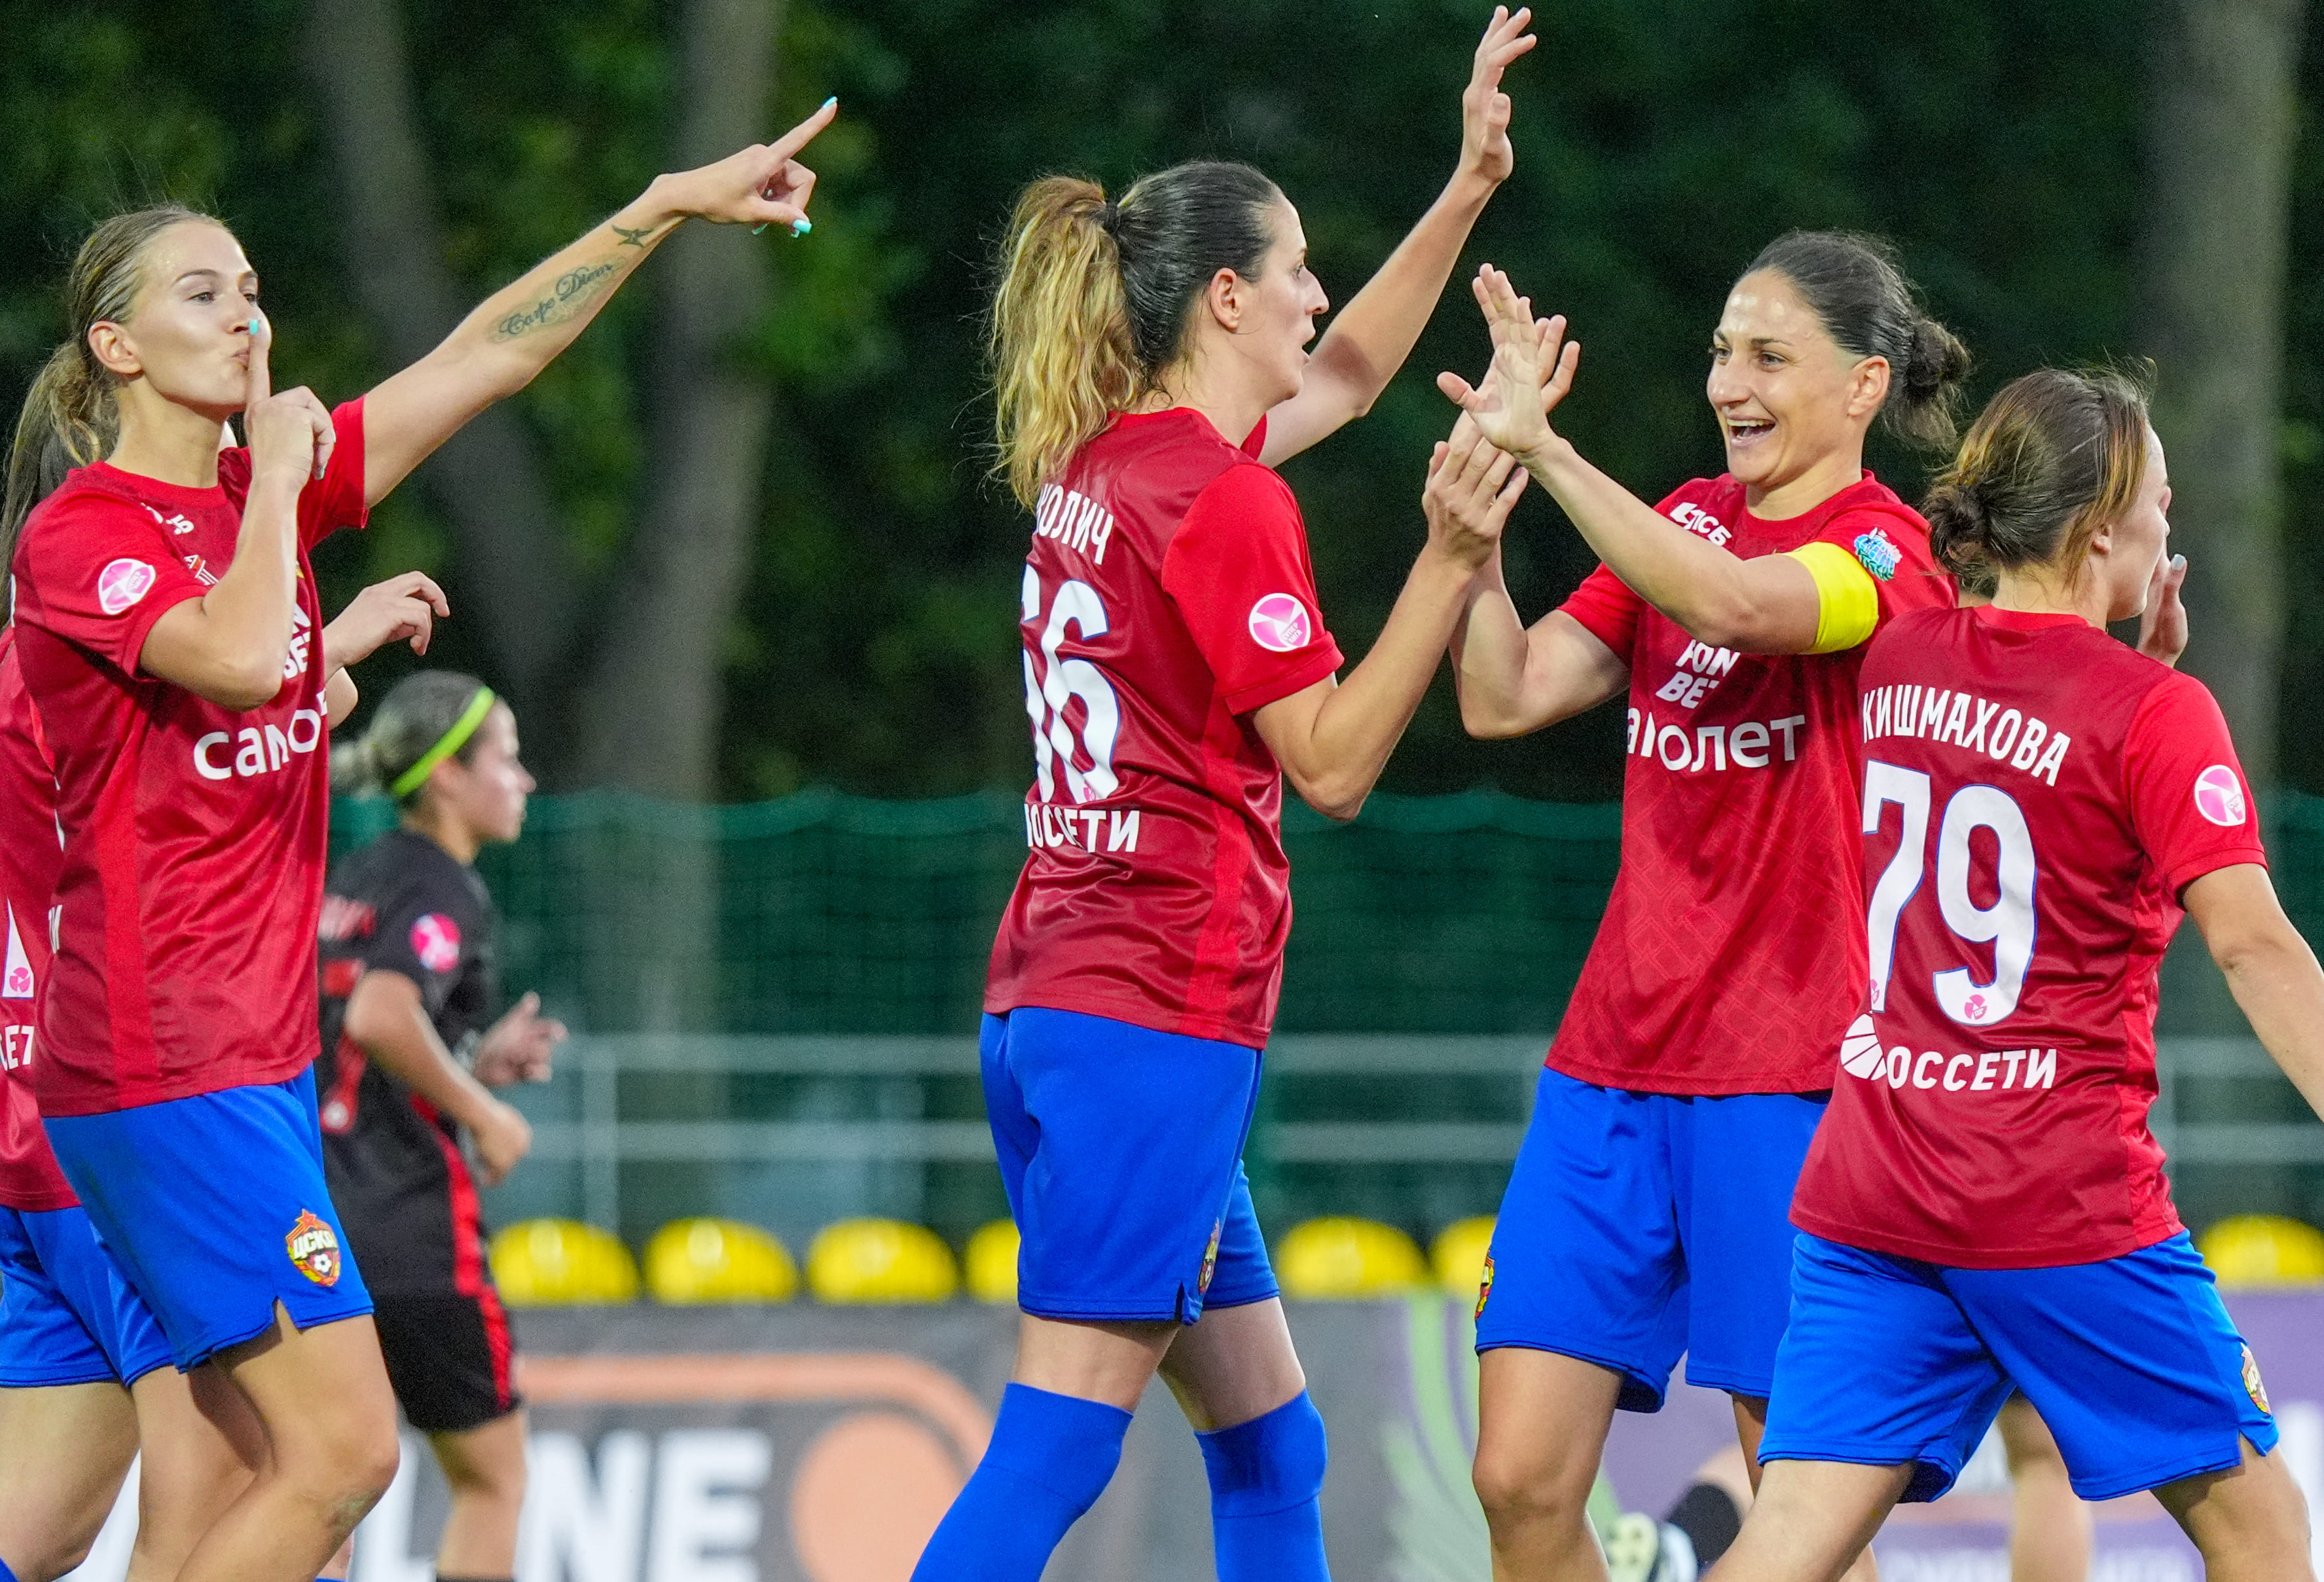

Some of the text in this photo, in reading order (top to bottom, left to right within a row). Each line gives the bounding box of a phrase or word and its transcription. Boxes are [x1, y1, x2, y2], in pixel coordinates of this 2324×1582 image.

[1655, 671, 1720, 709] BE
[1862, 684, 2071, 786] КИШМАХОВА
[1862, 758, 2038, 1027] 79
